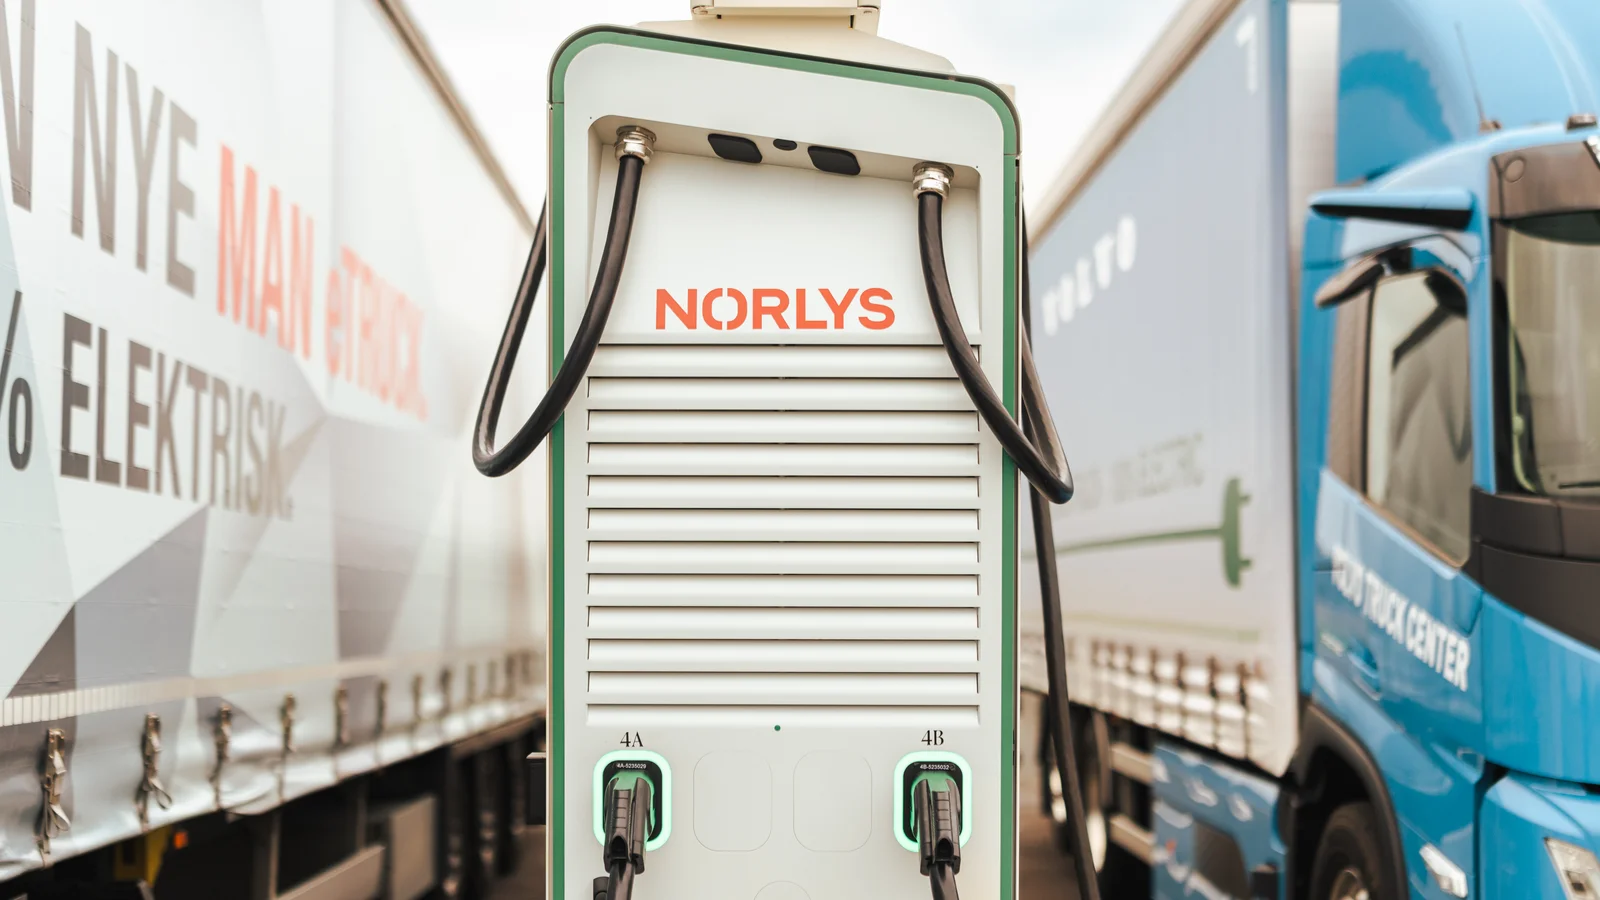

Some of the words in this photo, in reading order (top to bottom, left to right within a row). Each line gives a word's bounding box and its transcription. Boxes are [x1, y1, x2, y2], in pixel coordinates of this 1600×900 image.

[70, 20, 198, 299] NYE
[217, 140, 314, 362] MAN
[656, 287, 896, 331] NORLYS
[1406, 603, 1471, 693] CENTER
[620, 731, 644, 748] 4A
[920, 729, 945, 746] 4B
